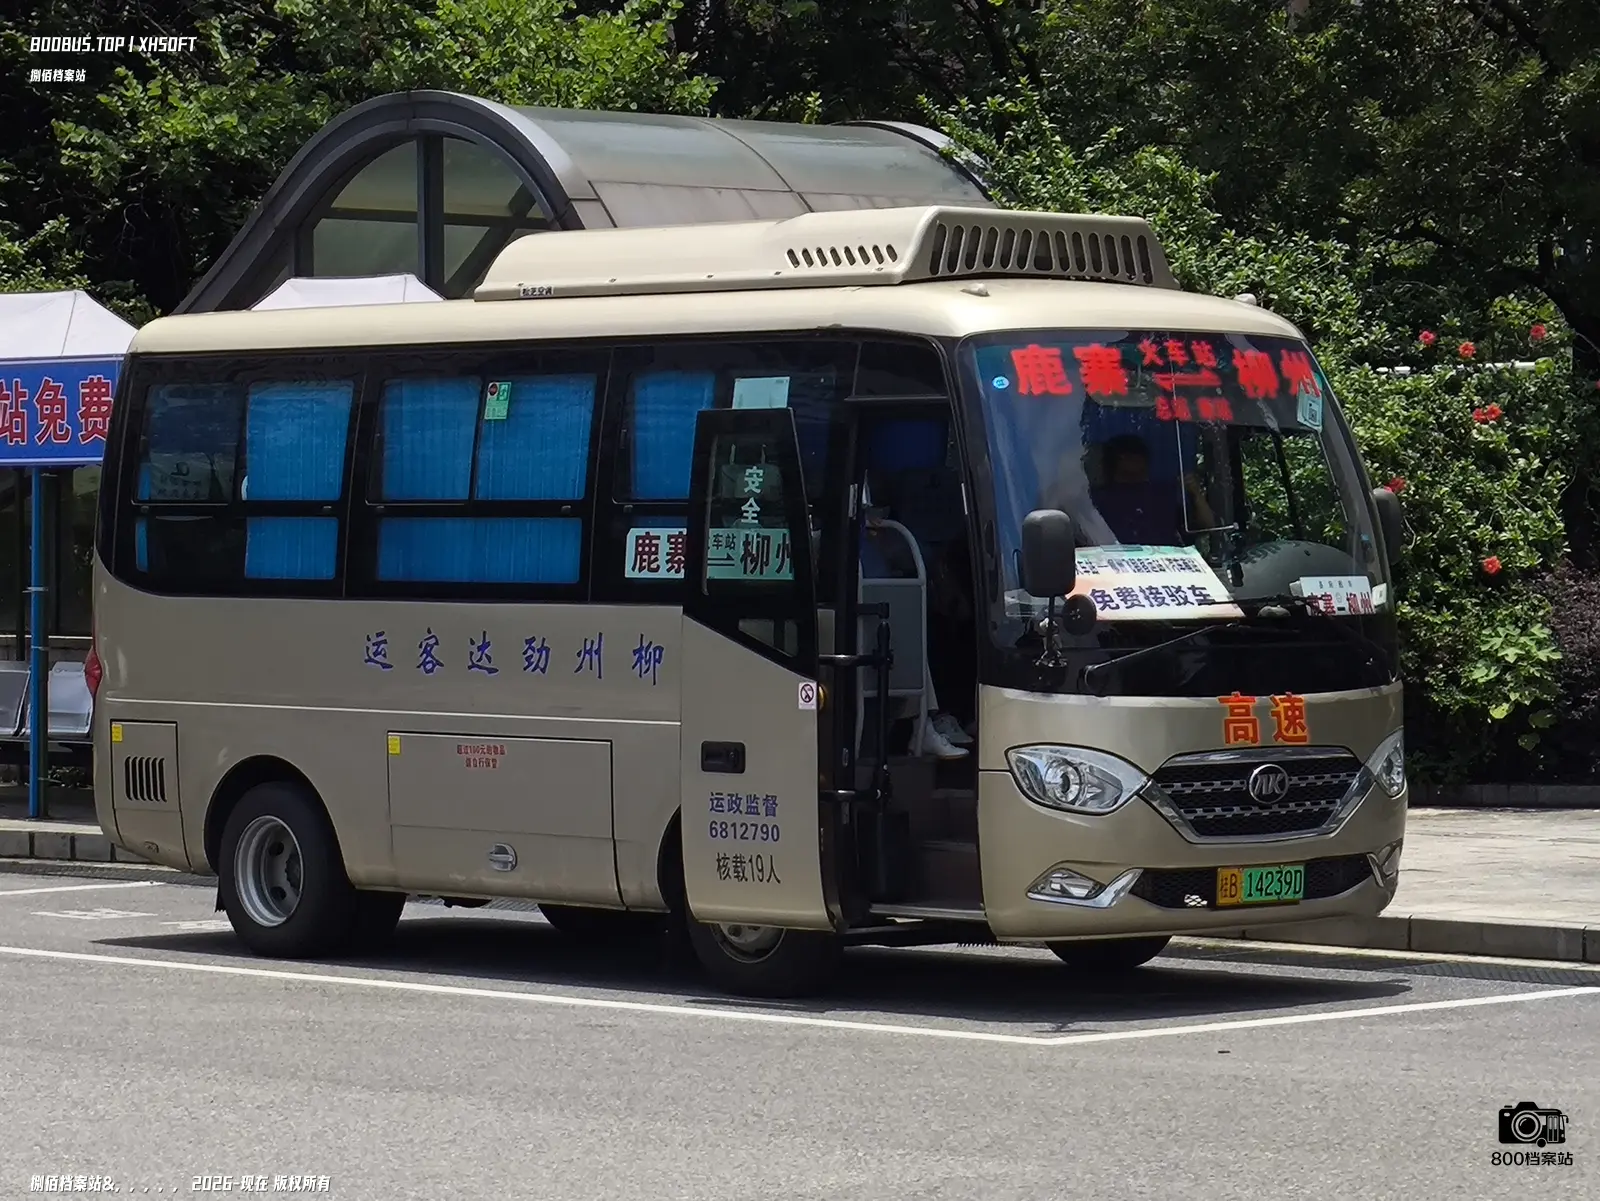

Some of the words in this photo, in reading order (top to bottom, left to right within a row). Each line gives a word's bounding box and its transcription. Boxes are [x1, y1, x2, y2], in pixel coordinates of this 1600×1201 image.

[741, 466, 764, 524] 安全
[1218, 692, 1308, 744] 高速
[710, 792, 778, 817] 运政监督
[710, 821, 780, 842] 6812790
[716, 852, 781, 884] 核载19人
